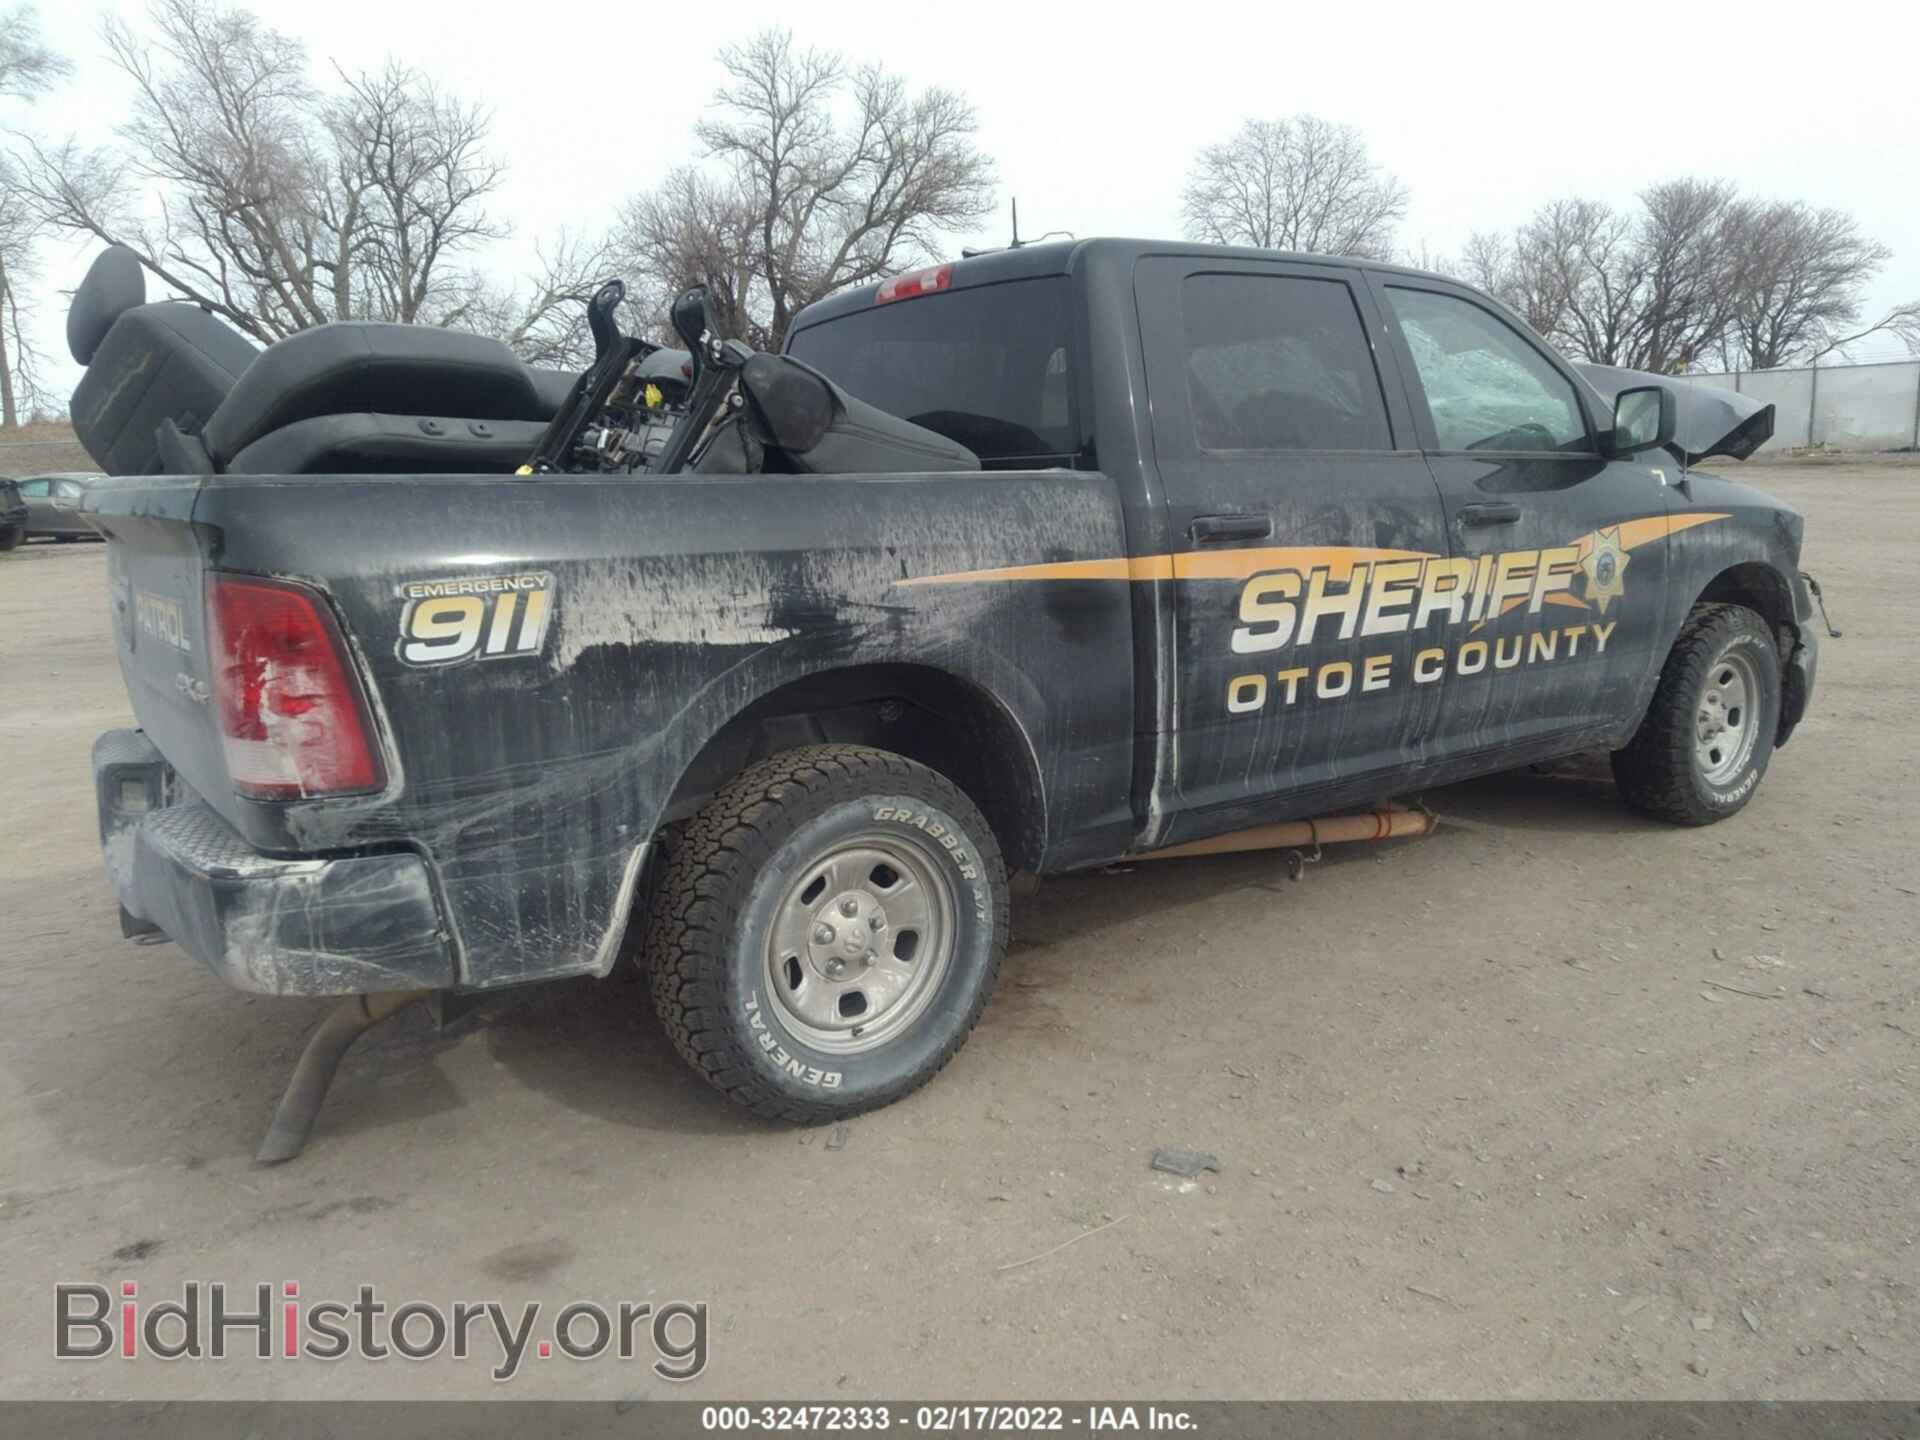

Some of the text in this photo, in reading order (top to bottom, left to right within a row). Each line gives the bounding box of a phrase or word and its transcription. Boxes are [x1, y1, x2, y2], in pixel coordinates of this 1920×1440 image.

[404, 590, 547, 662] 911
[408, 575, 548, 598] EMERGENCY
[1231, 543, 1581, 655] SHERIFF
[1227, 621, 1617, 714] OTOE COUNTY
[872, 806, 978, 880] GRABBER
[744, 989, 843, 1089] GENERAL
